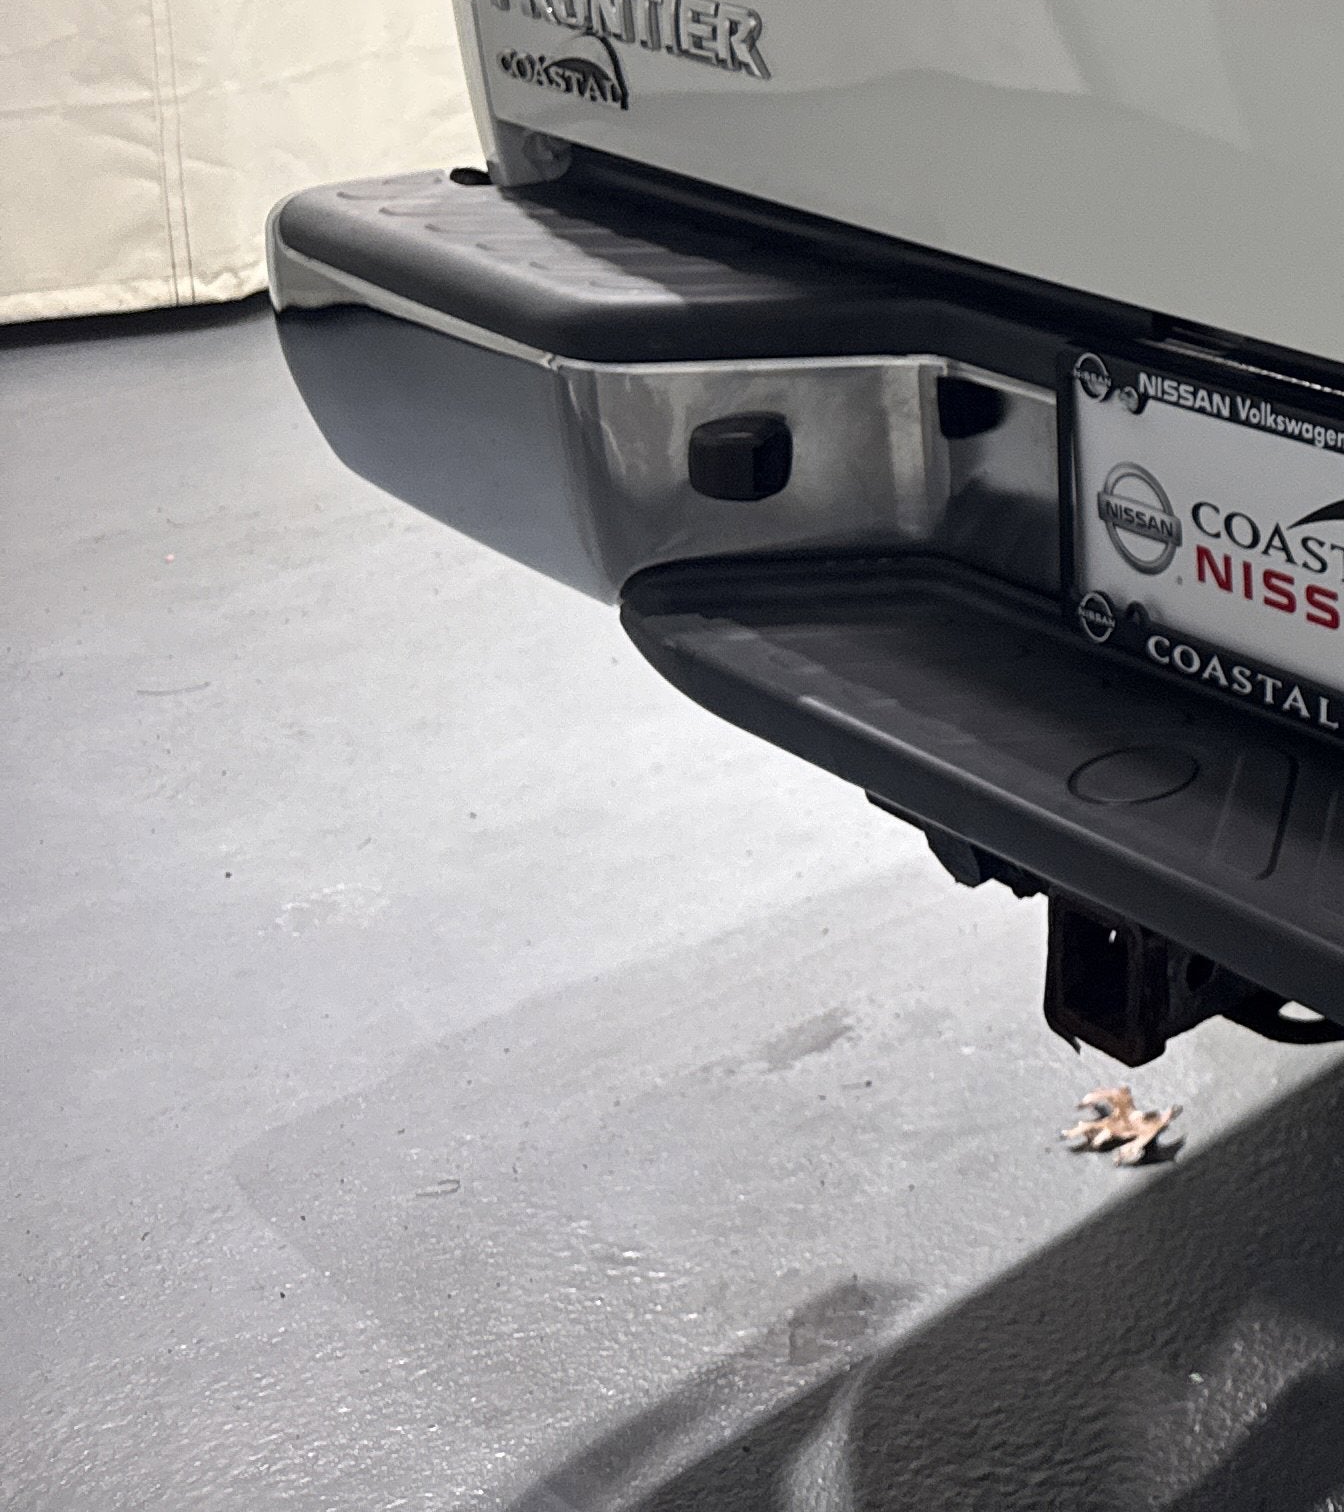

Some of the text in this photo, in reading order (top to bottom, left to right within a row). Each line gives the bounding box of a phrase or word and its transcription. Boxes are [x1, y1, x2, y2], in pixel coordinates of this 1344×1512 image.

[498, 48, 626, 107] COASTAL
[1138, 371, 1231, 418] NISSAN
[1104, 499, 1175, 538] NISSAN
[1146, 634, 1340, 730] COASTAL
